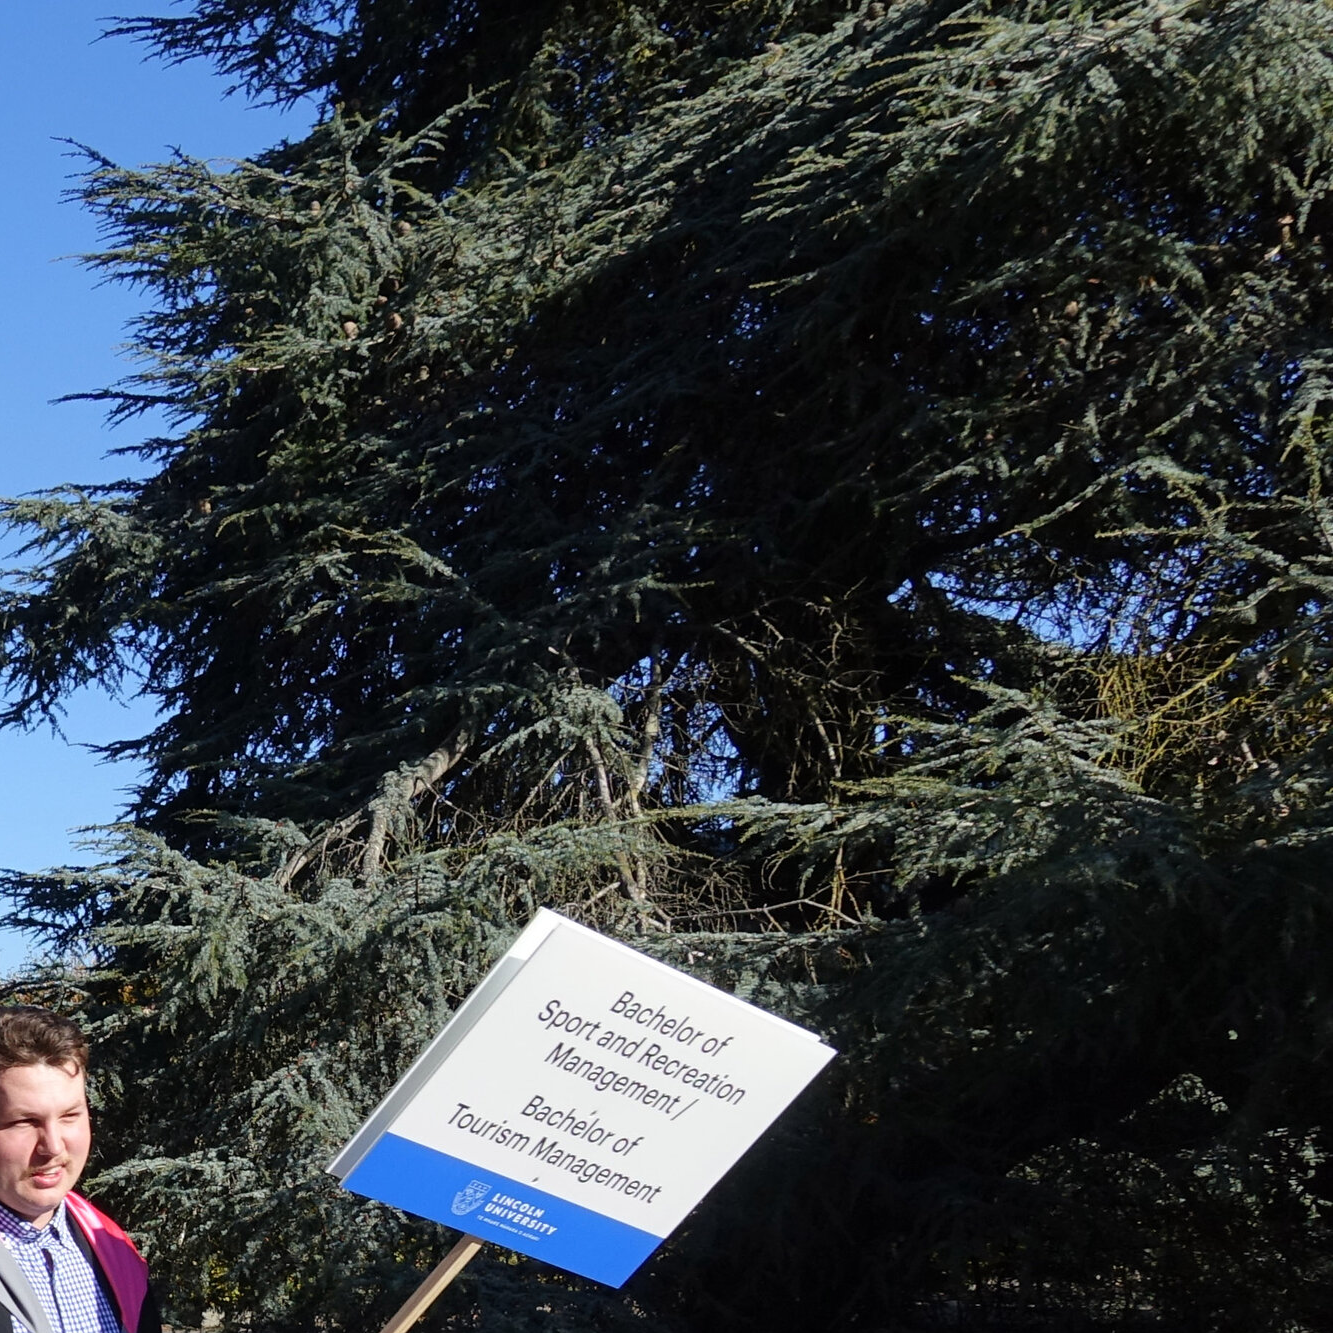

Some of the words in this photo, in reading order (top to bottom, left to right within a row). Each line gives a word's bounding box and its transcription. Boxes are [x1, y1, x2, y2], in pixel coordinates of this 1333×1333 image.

[538, 999, 602, 1042] Sport
[596, 1030, 647, 1059] and
[637, 1043, 746, 1106] Recreation
[609, 990, 705, 1046] Bachelor
[701, 1036, 734, 1057] of
[544, 1042, 681, 1115] Management
[670, 1098, 700, 1121] /
[448, 1102, 531, 1153] Tourism
[528, 1136, 662, 1204] Management
[520, 1095, 615, 1147] Bachelor
[612, 1136, 645, 1157] of
[484, 1202, 558, 1236] UNIVERSITY
[492, 1192, 546, 1219] LINCOLN
